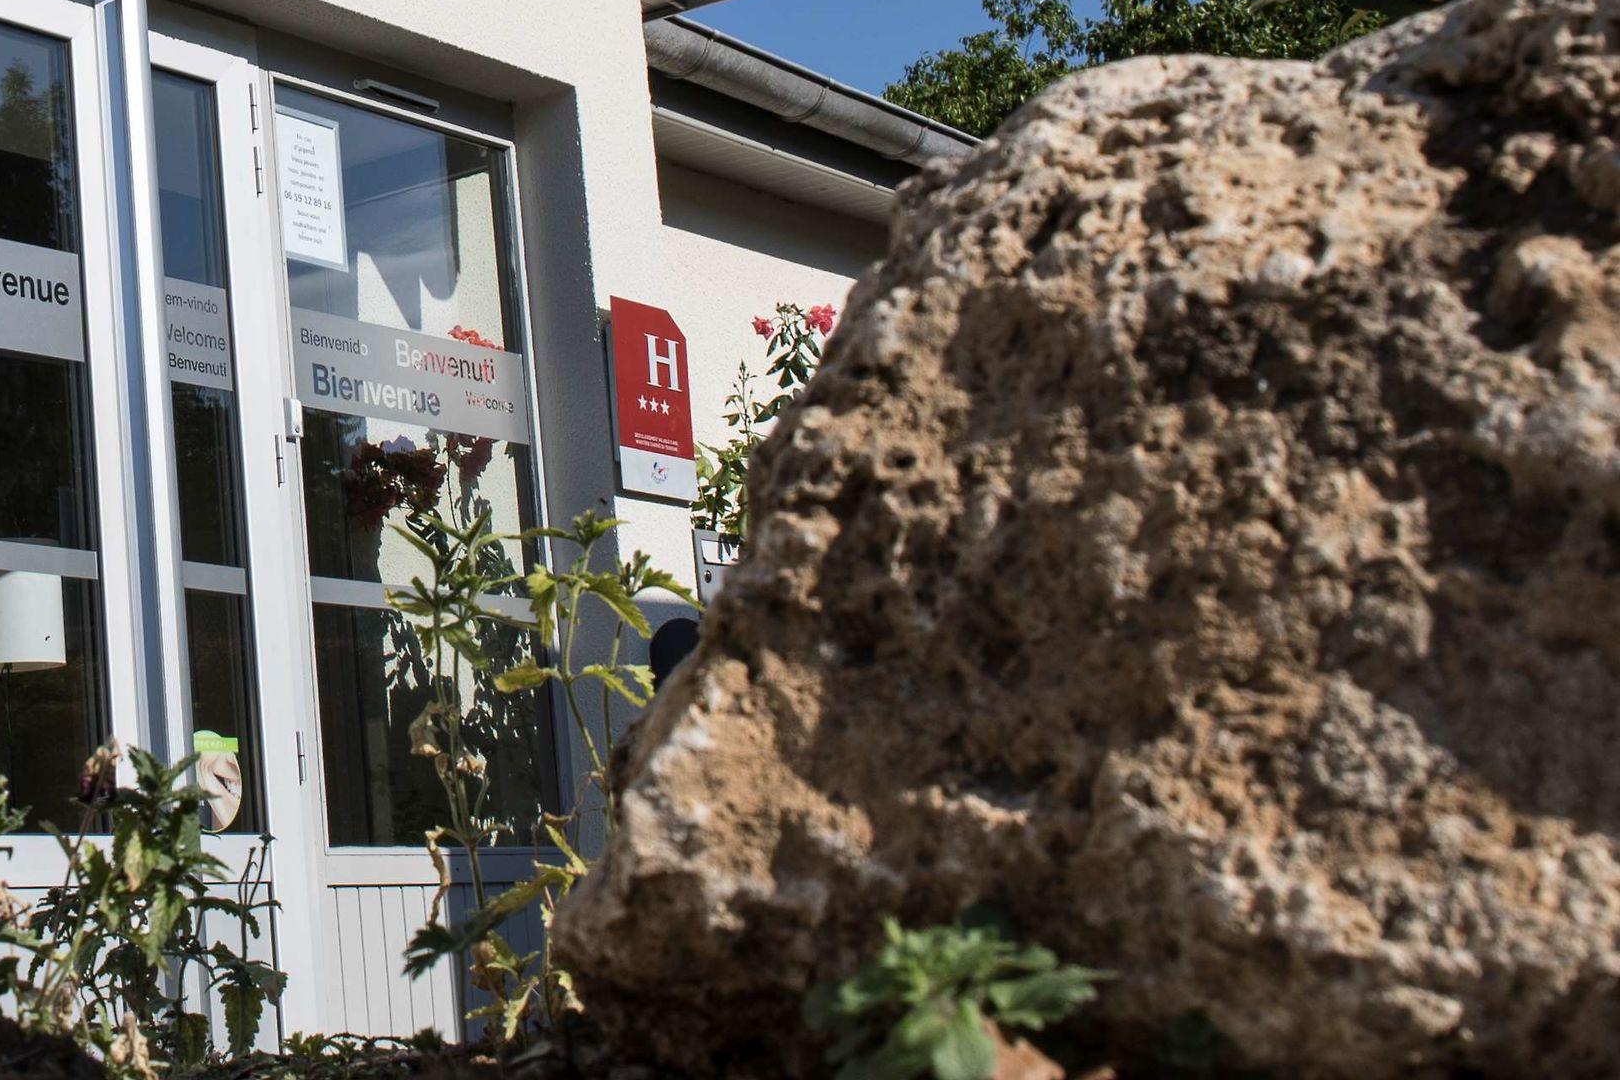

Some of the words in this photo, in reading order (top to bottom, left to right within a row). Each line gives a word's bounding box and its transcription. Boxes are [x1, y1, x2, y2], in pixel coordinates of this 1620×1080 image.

[164, 293, 219, 315] em-vindo
[300, 327, 369, 357] Bienvenido
[168, 351, 228, 377] Benvenuti
[394, 338, 497, 385] Benvenuti
[644, 332, 682, 392] H
[311, 362, 441, 417] Bienvenue
